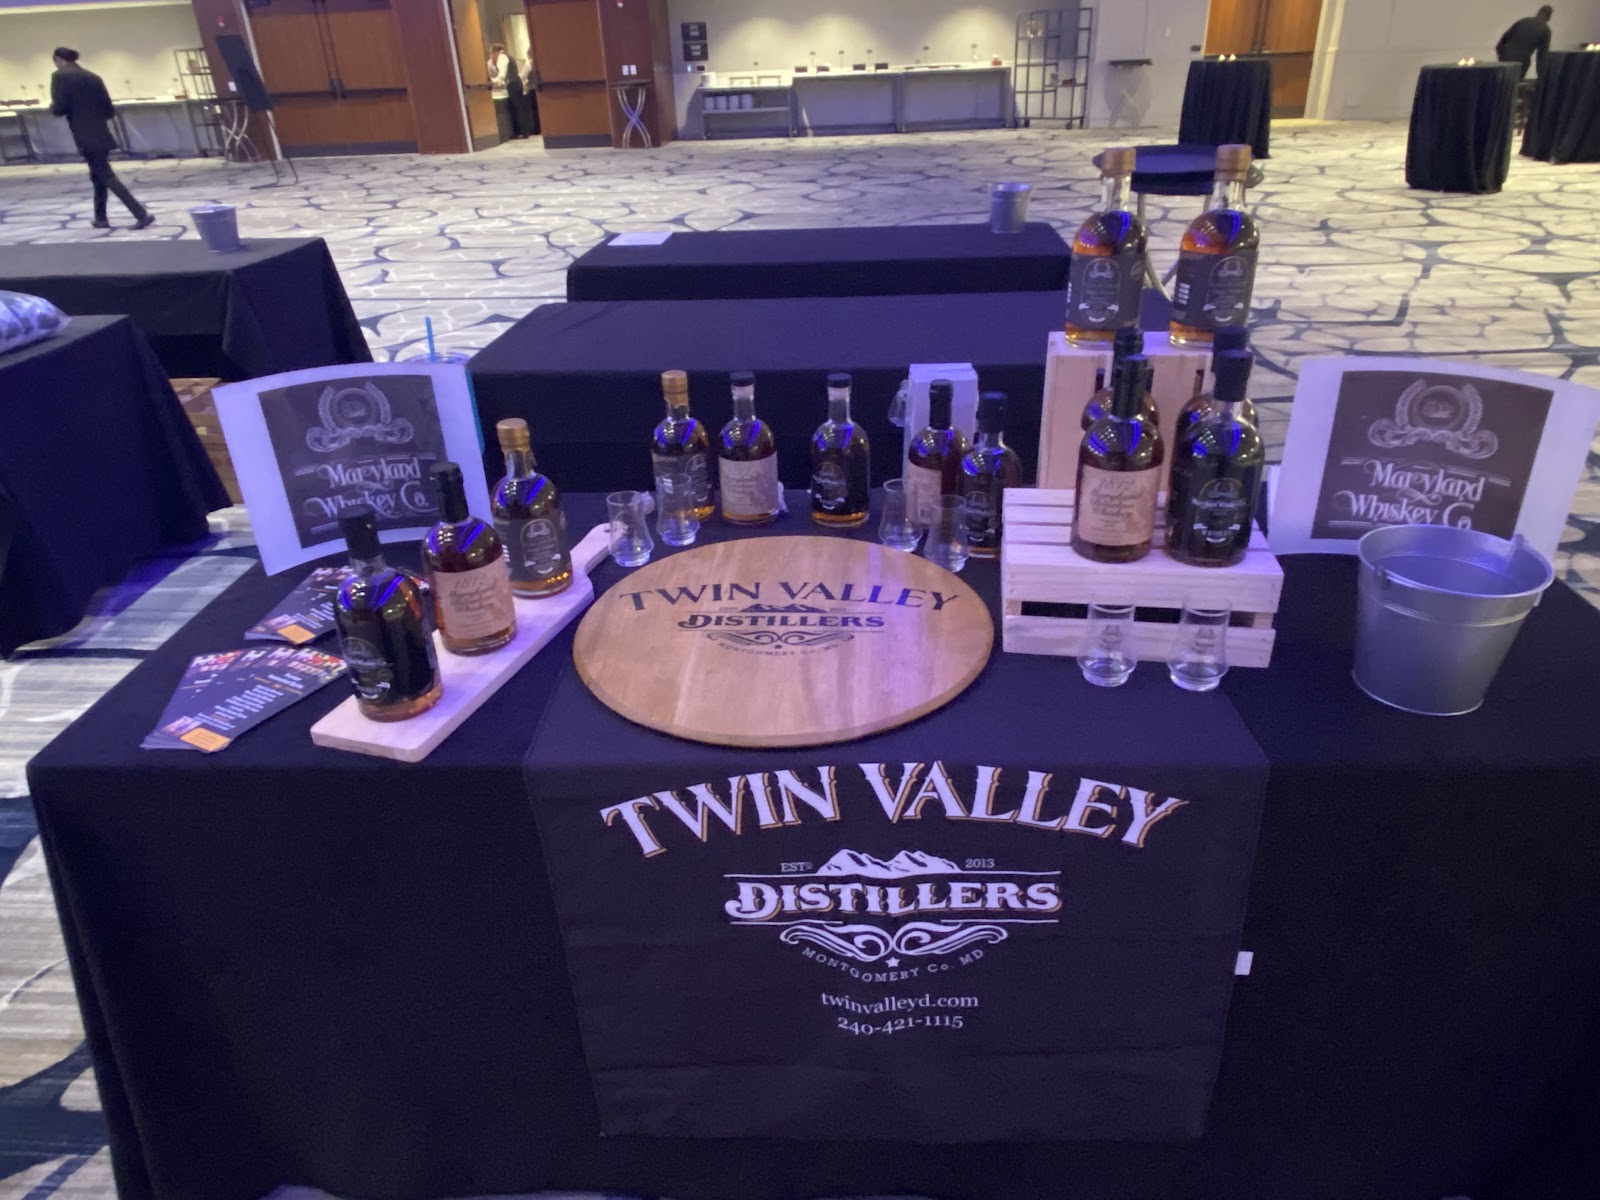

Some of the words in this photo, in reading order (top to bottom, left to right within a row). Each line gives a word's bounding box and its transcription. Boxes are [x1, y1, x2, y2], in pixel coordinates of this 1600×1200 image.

[316, 456, 421, 491] Maryland
[1363, 459, 1484, 506] Maryland
[1333, 490, 1438, 525] Whiskey
[619, 582, 761, 612] TWIN
[779, 582, 960, 611] VALLEY
[718, 642, 795, 656] MONTGOMERY
[600, 765, 840, 858] TWIN
[858, 760, 1190, 848] VALLEY
[965, 858, 995, 869] 2013
[802, 946, 919, 983] MONTGOMERY
[959, 949, 984, 967] MD
[820, 991, 979, 1015] twinvalleyd.com
[837, 1014, 964, 1036] 240-421-1115
